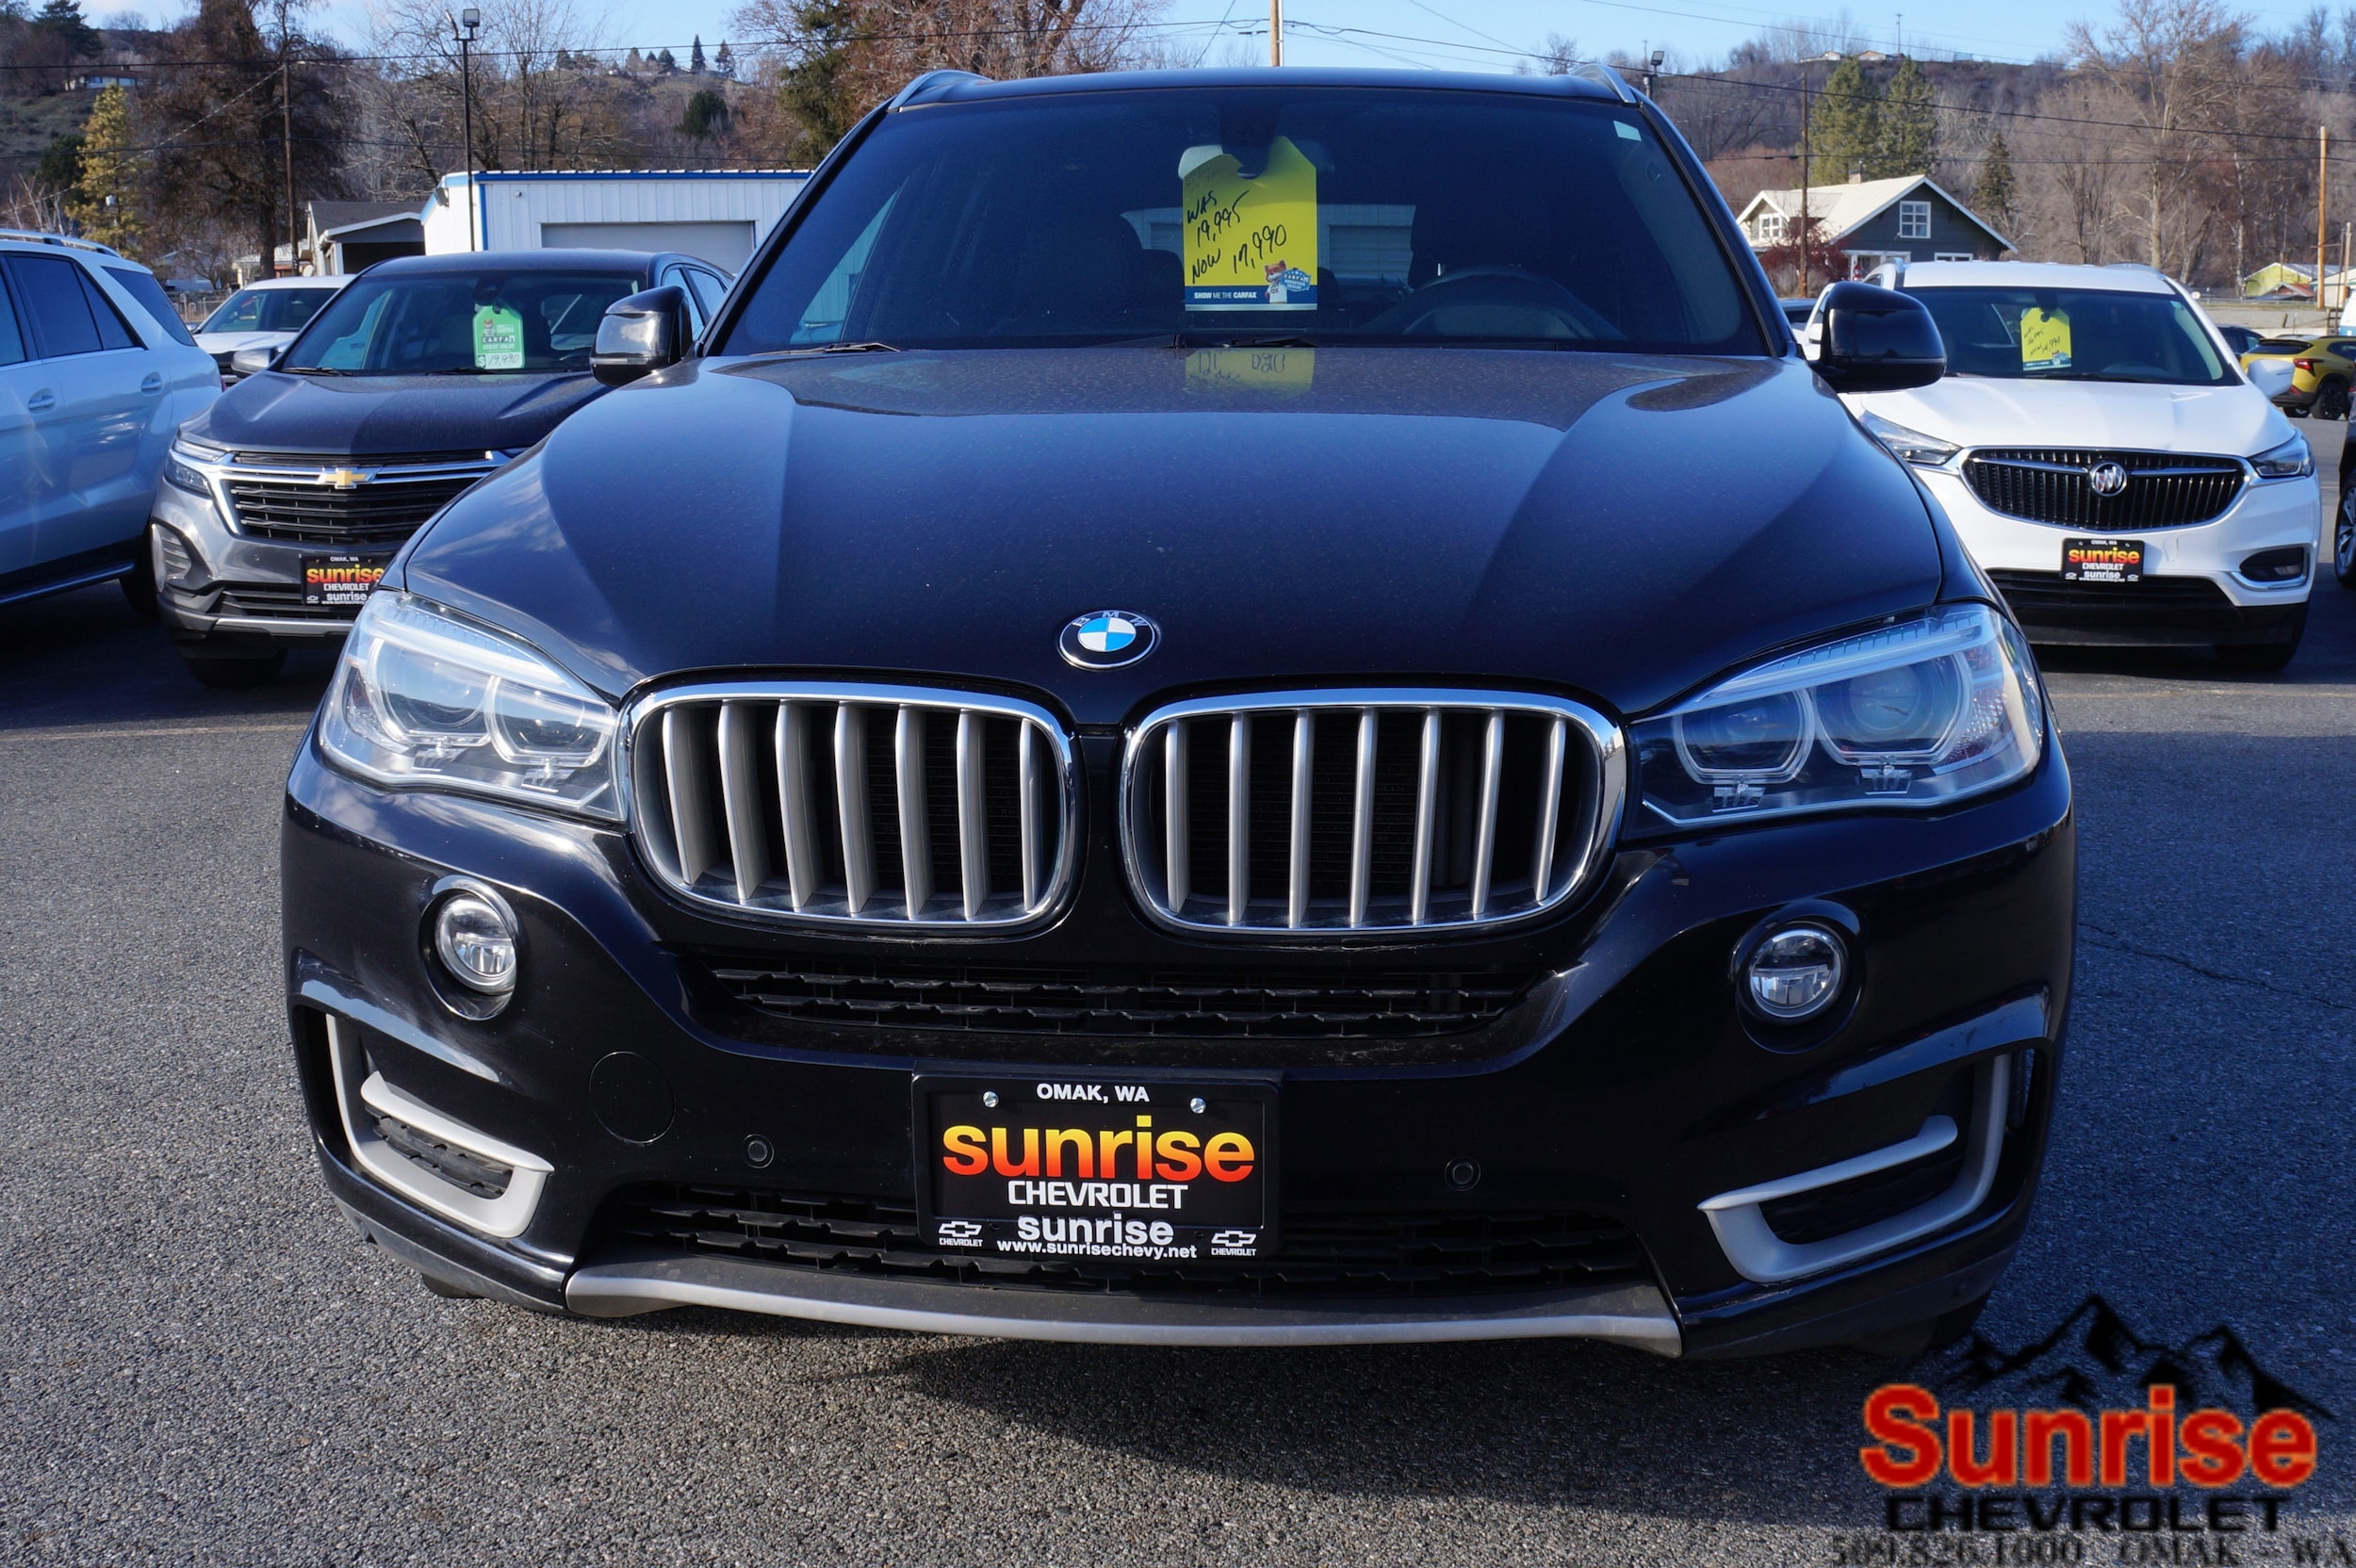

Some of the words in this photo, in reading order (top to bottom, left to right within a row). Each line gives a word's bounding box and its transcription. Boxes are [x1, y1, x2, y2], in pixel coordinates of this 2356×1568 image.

[1186, 190, 1218, 224] WAS
[1196, 189, 1251, 248] 19,995
[1191, 248, 1221, 284] NOW
[1233, 224, 1287, 274] 17,990
[1194, 291, 1213, 300] SHOW
[1213, 291, 1222, 300] ME
[1222, 291, 1233, 300] THE
[1233, 291, 1257, 300] CARFAX
[2068, 547, 2140, 564] sunrise
[2084, 570, 2120, 580] sunrise
[326, 592, 368, 601] sunrise
[1071, 610, 1149, 628] BMW
[1036, 1083, 1109, 1104] OMAK,
[1114, 1085, 1151, 1102] WA
[942, 1114, 1255, 1183] sunrise
[1007, 1180, 1189, 1209] CHEVROLET
[1017, 1212, 1174, 1246] sunrise
[939, 1237, 983, 1248] CHEVROLET
[996, 1238, 1197, 1261] www.sunrisechevy.net
[1210, 1247, 1257, 1257] CHEVROLET
